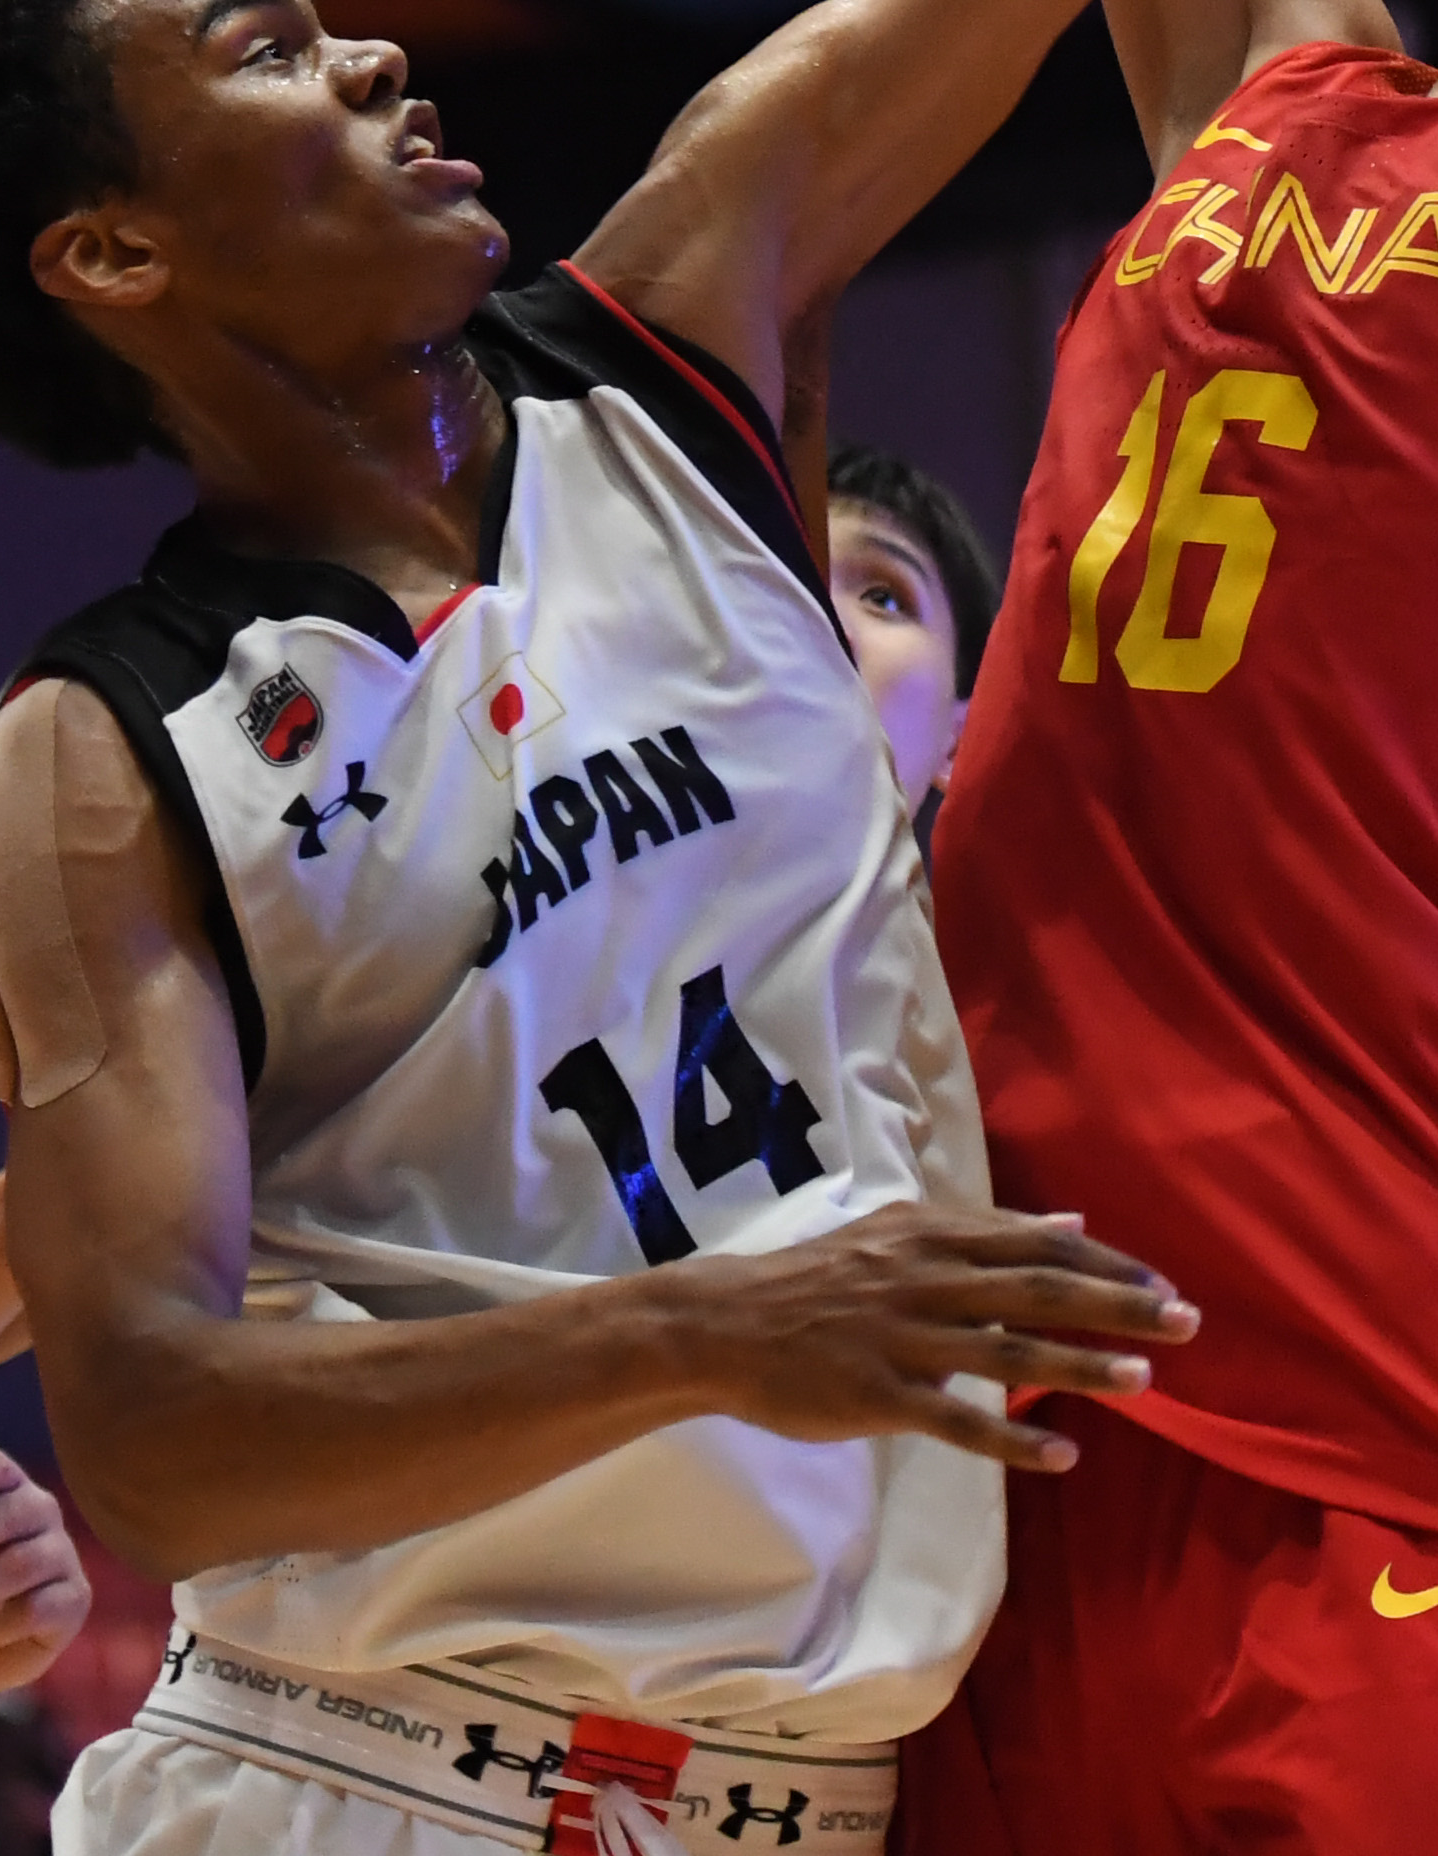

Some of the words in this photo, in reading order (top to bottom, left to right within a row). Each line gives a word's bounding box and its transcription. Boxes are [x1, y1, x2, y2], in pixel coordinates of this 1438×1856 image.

[1058, 369, 1319, 694] 16
[248, 669, 293, 732] JAPAN
[476, 725, 737, 969] JAPAN
[539, 964, 827, 1267] 14
[192, 1652, 310, 1701] ARMOUR
[315, 1690, 444, 1749] UNDER
